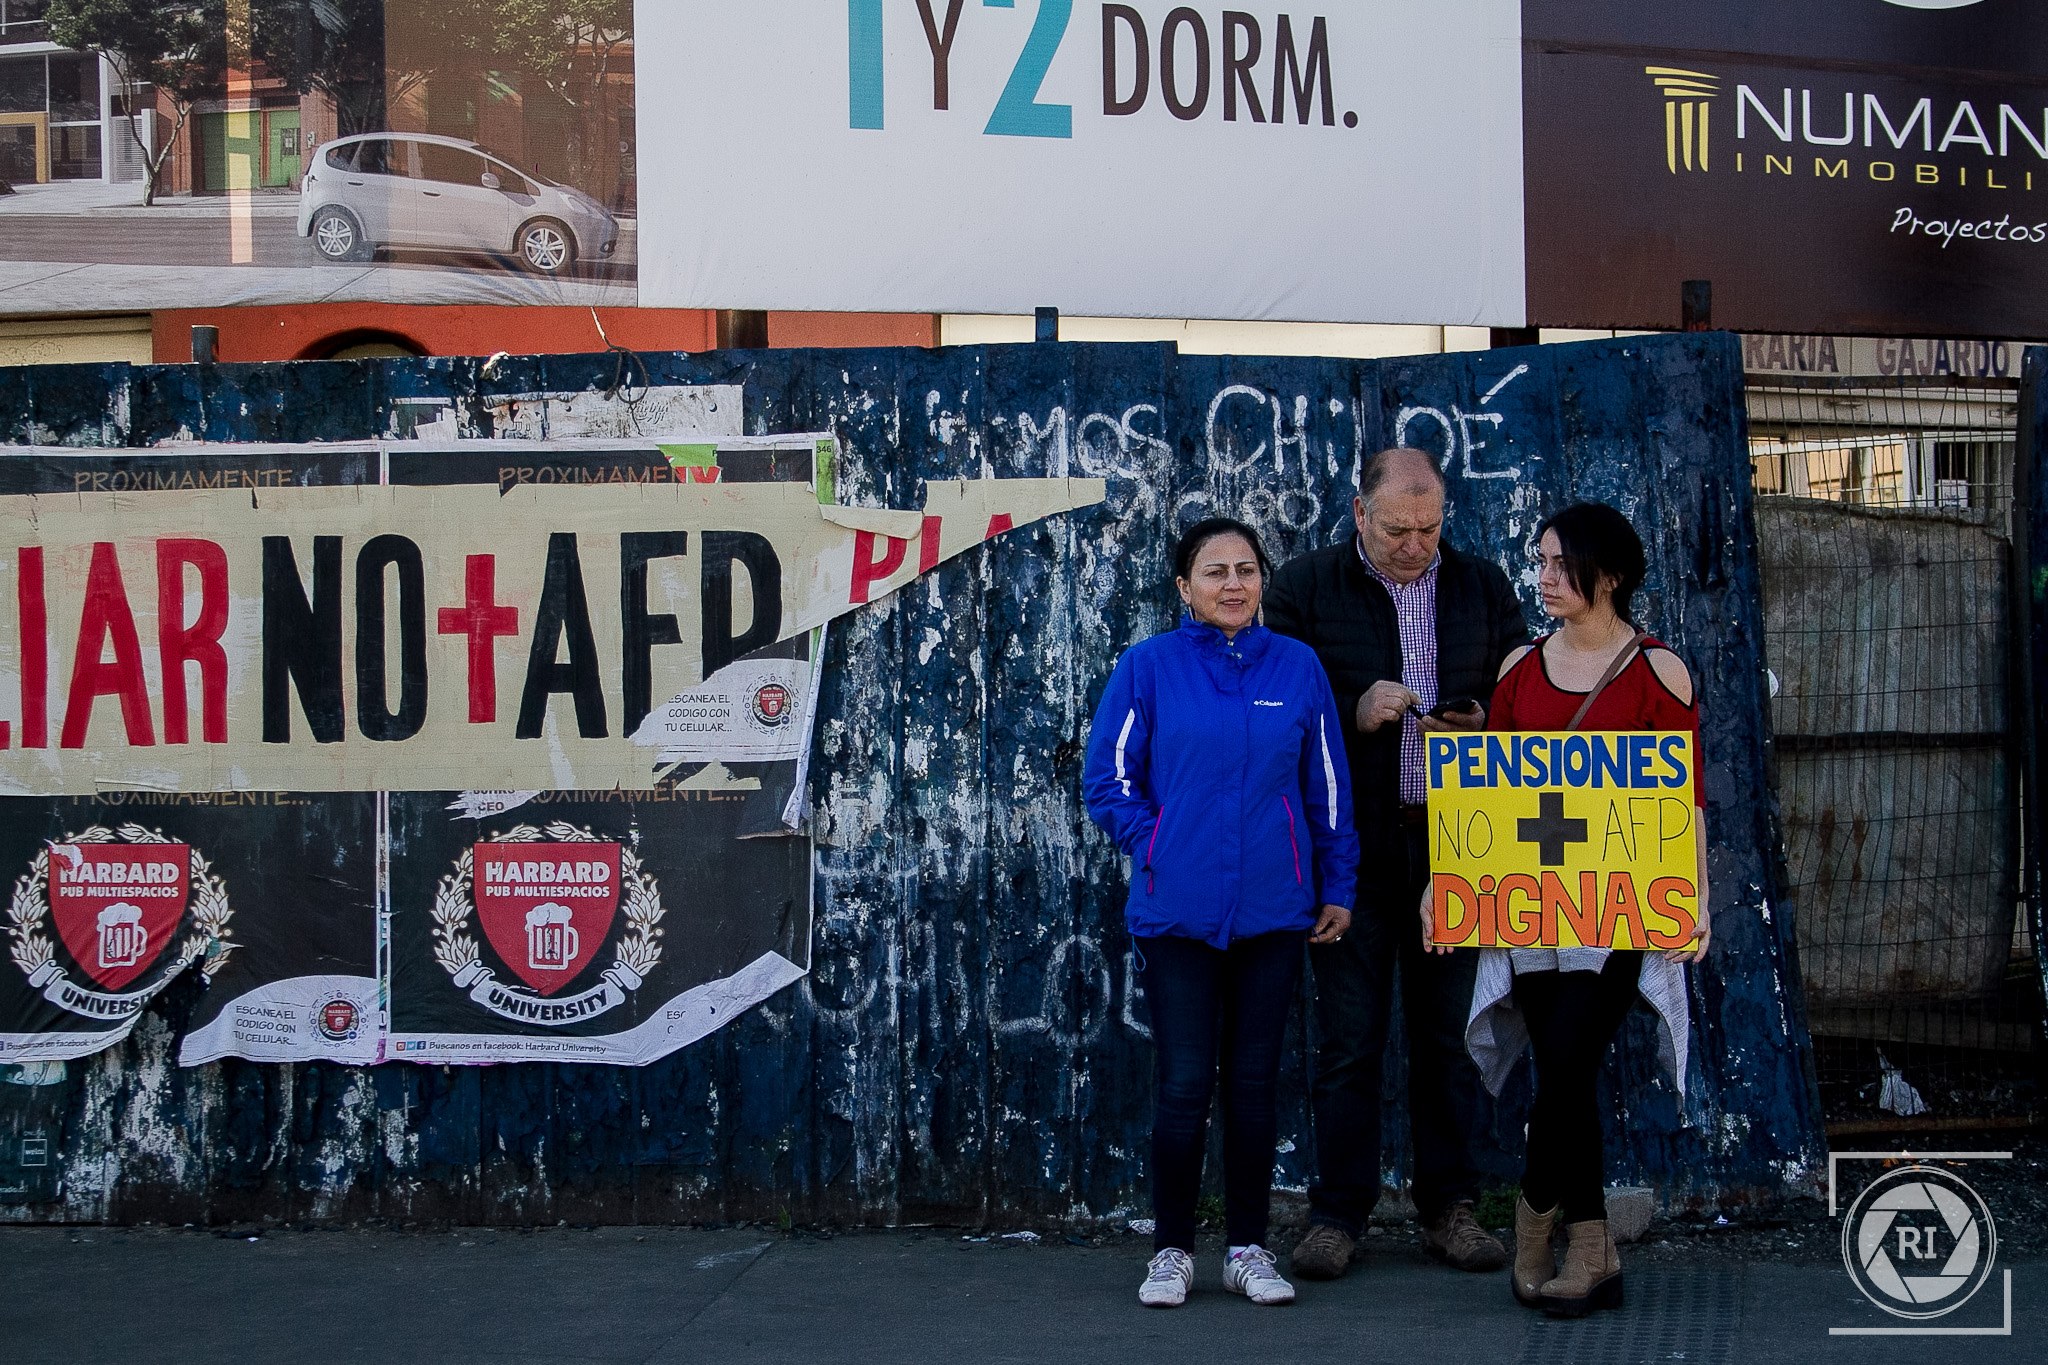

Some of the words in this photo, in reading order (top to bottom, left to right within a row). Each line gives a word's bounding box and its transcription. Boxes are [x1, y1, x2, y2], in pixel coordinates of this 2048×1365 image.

[1102, 3, 1358, 129] DORM.
[1736, 152, 2032, 190] INMOBILI
[1890, 207, 2047, 248] Proyectos
[1876, 336, 2011, 379] GAJARDO
[75, 469, 292, 491] PROXIMAMENTE
[0, 538, 229, 749] IAR
[719, 694, 731, 703] EL
[668, 708, 707, 718] CODIGO
[709, 708, 730, 718] CON
[665, 723, 677, 732] TU
[1429, 735, 1688, 789] PENSIONES
[1437, 809, 1493, 861] NO
[1602, 797, 1691, 863] AFP
[60, 862, 180, 884] HARBARD
[485, 861, 611, 883] HARBARD
[60, 886, 84, 897] PUB
[87, 886, 180, 898] MULTIESPACIOS
[485, 886, 510, 897] PUB
[514, 886, 611, 898] MULTIESPACIOS
[236, 1005, 283, 1020] ESCANEA
[284, 1011, 297, 1020] EL
[488, 988, 608, 1021] UNIVERSITY
[233, 1030, 245, 1040] TU
[236, 1018, 275, 1030] CODIGO
[276, 1023, 297, 1034] CON
[429, 1041, 471, 1050] Buscanos
[526, 1042, 560, 1051] Harbard
[562, 1044, 607, 1054] University
